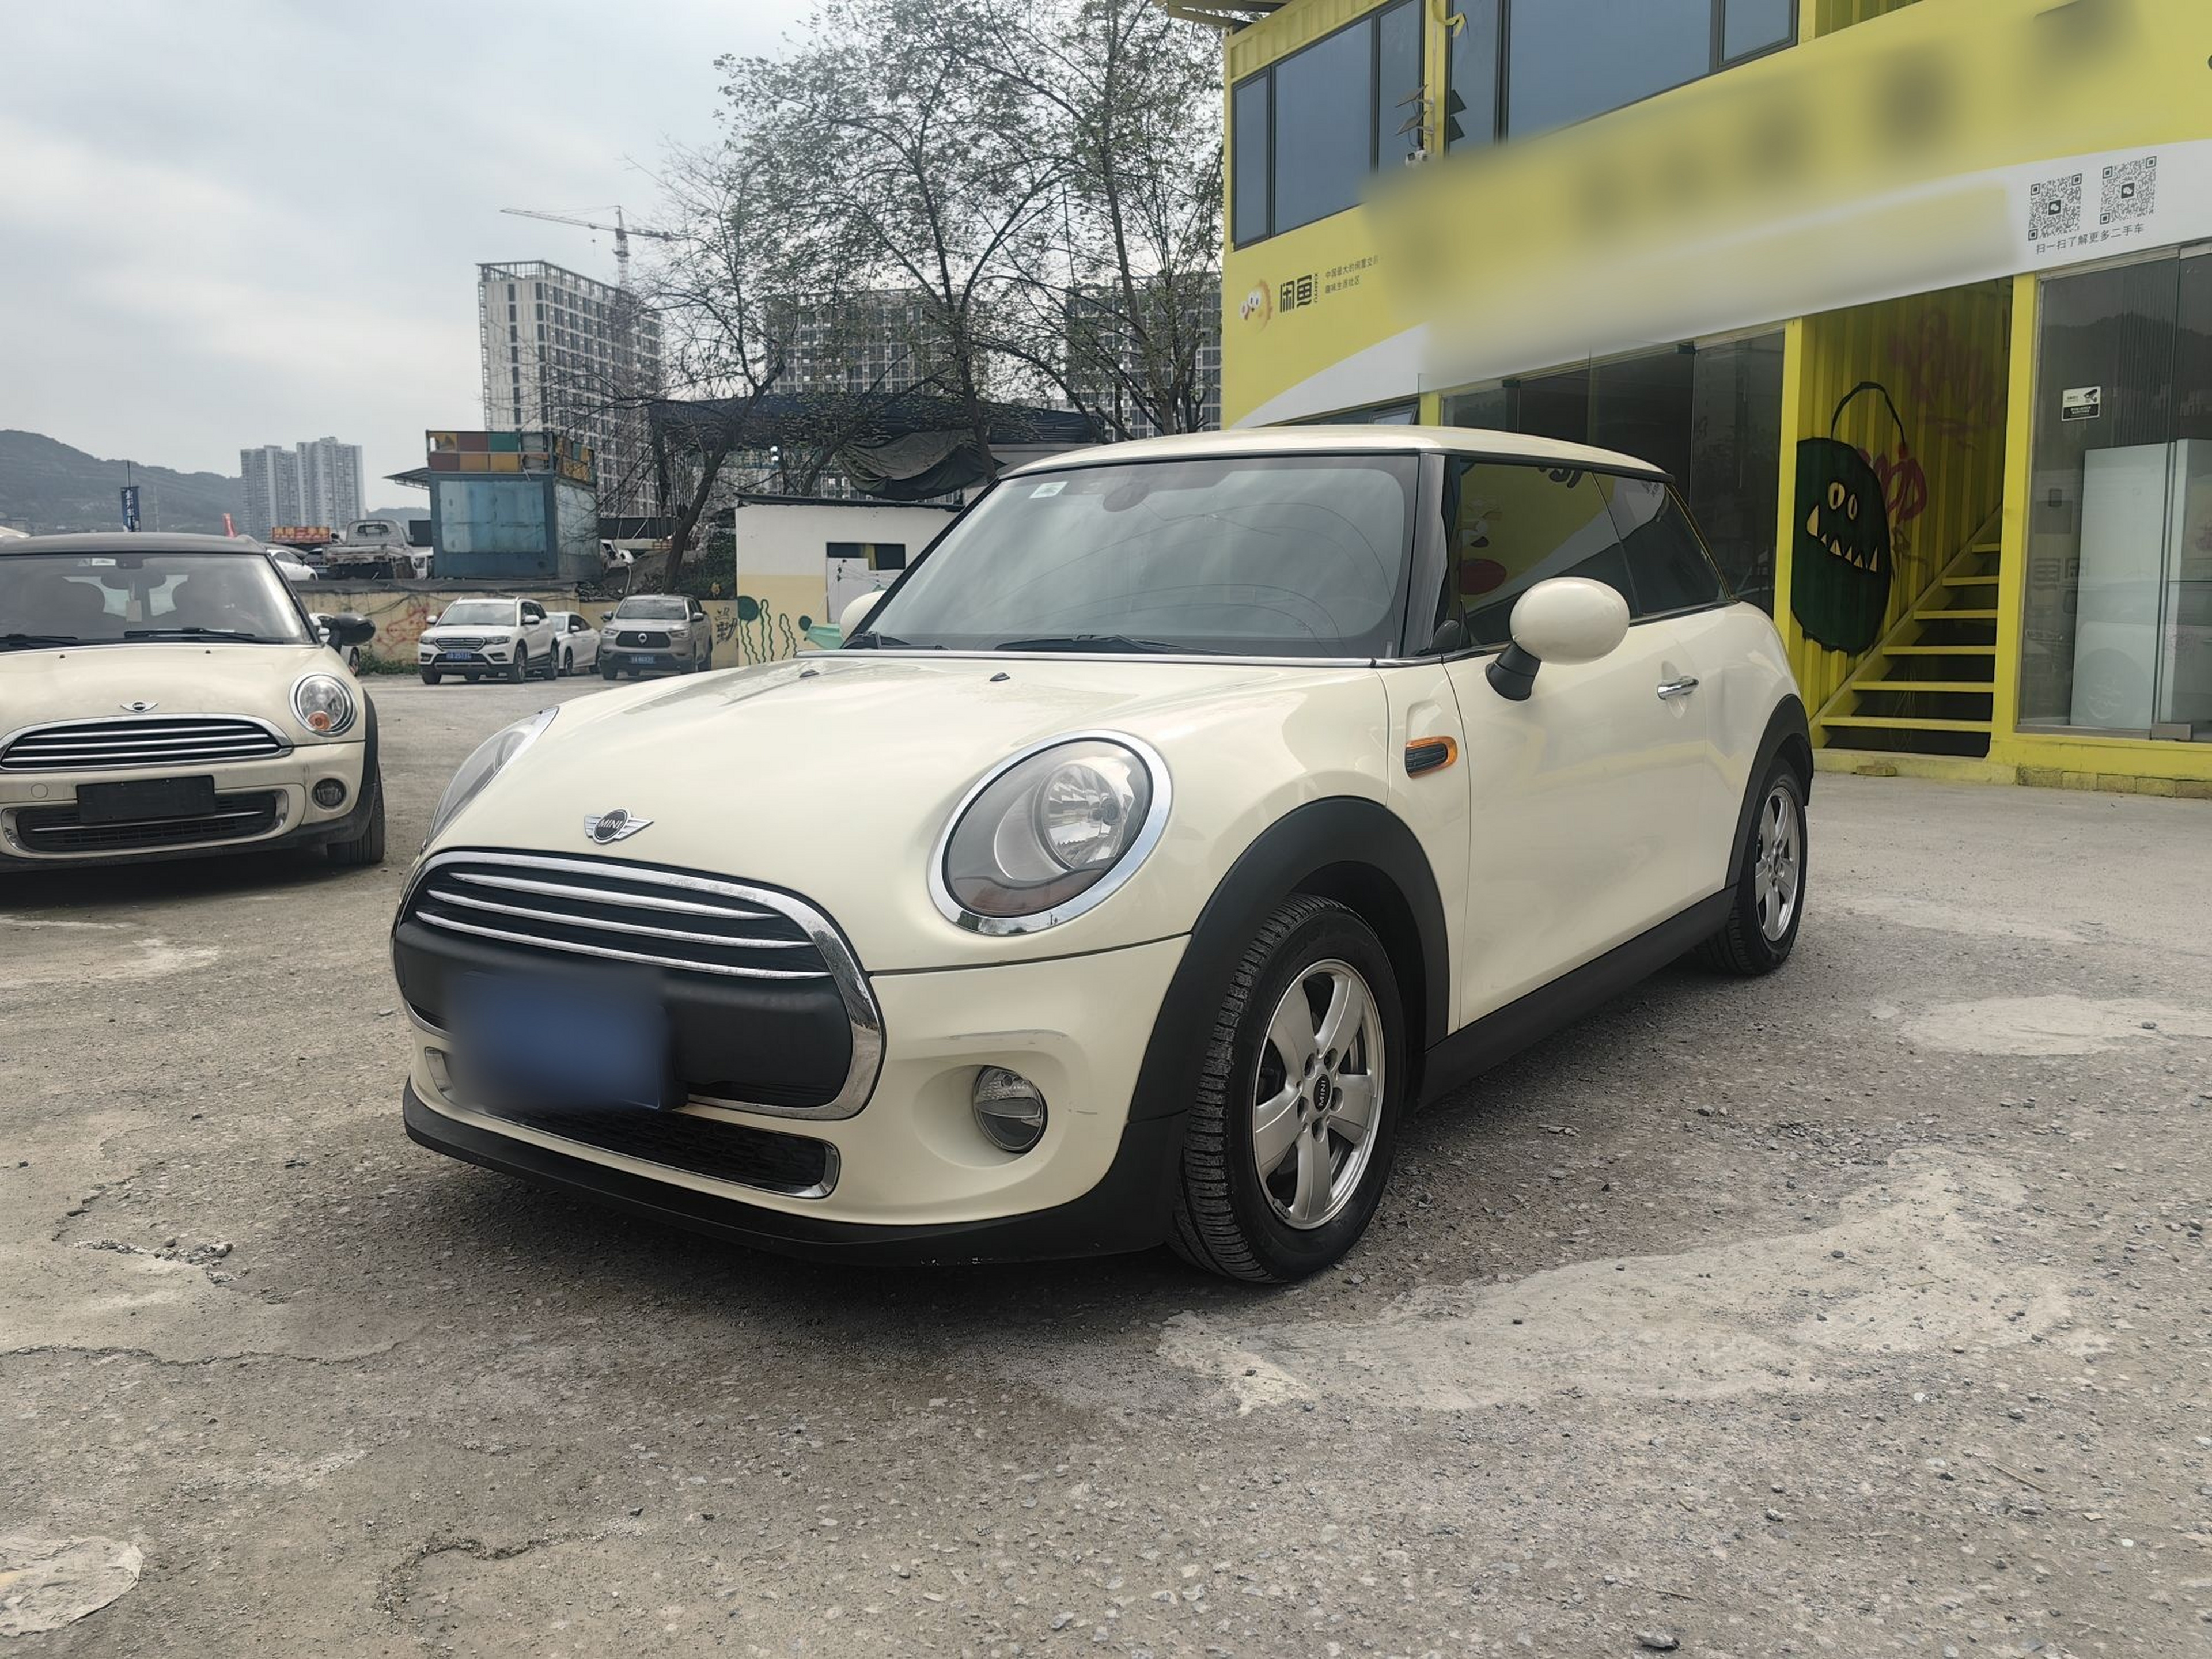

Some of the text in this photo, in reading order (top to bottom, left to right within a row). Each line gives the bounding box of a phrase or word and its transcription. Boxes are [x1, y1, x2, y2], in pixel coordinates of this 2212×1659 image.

[2036, 222, 2143, 255] 扫一扫了解更多二手车
[1280, 275, 1312, 313] 闲鱼
[598, 819, 623, 829] MINI
[1318, 1080, 1326, 1107] MINI
